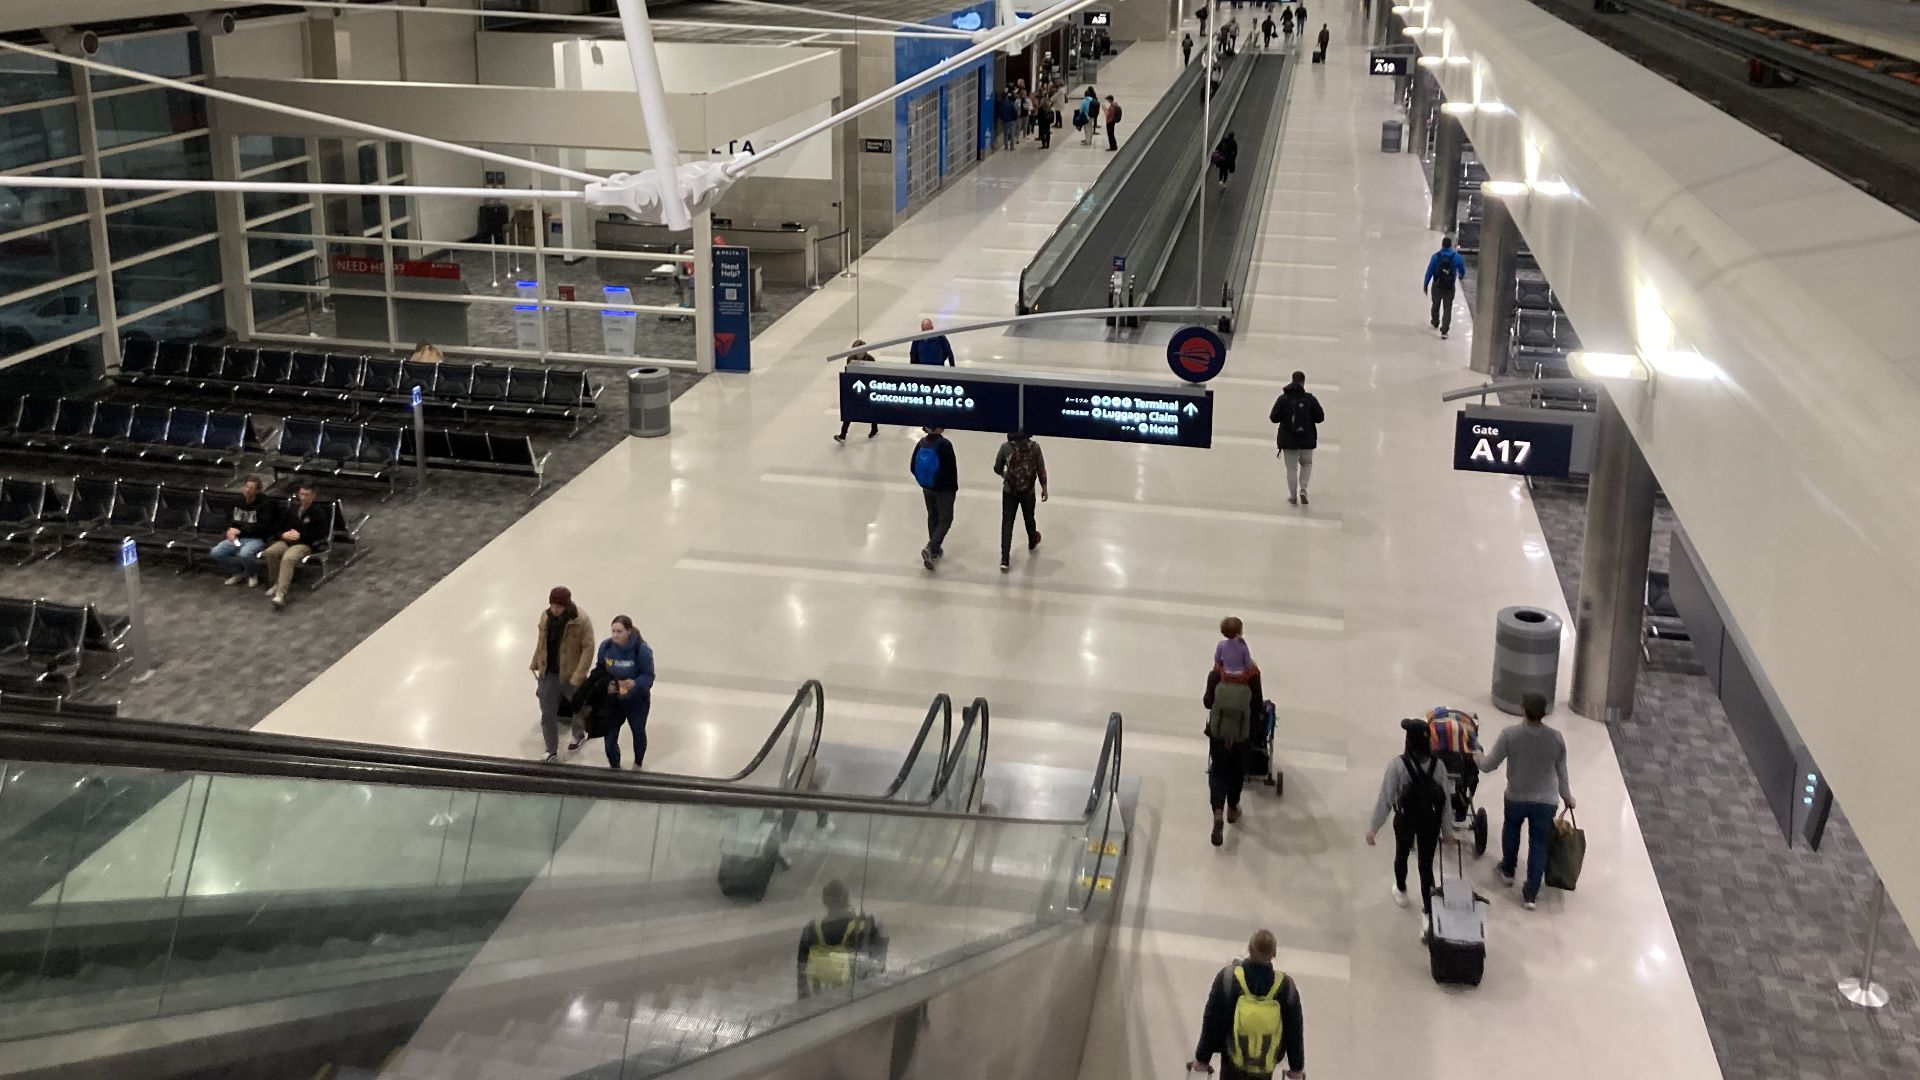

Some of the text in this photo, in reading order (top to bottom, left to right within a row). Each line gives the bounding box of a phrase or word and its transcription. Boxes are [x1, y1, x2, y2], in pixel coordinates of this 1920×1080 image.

[1374, 62, 1395, 73] A19
[337, 260, 405, 275] NEED HEP?
[869, 380, 953, 395] Gates A19 to A78
[869, 392, 963, 407] Concourses B and C
[1133, 398, 1179, 411] Terminal
[1102, 409, 1147, 423] Luggage
[1149, 412, 1179, 423] Claim
[1149, 424, 1179, 435] Hotel
[1472, 425, 1499, 436] Gate
[1470, 438, 1531, 464] A17
